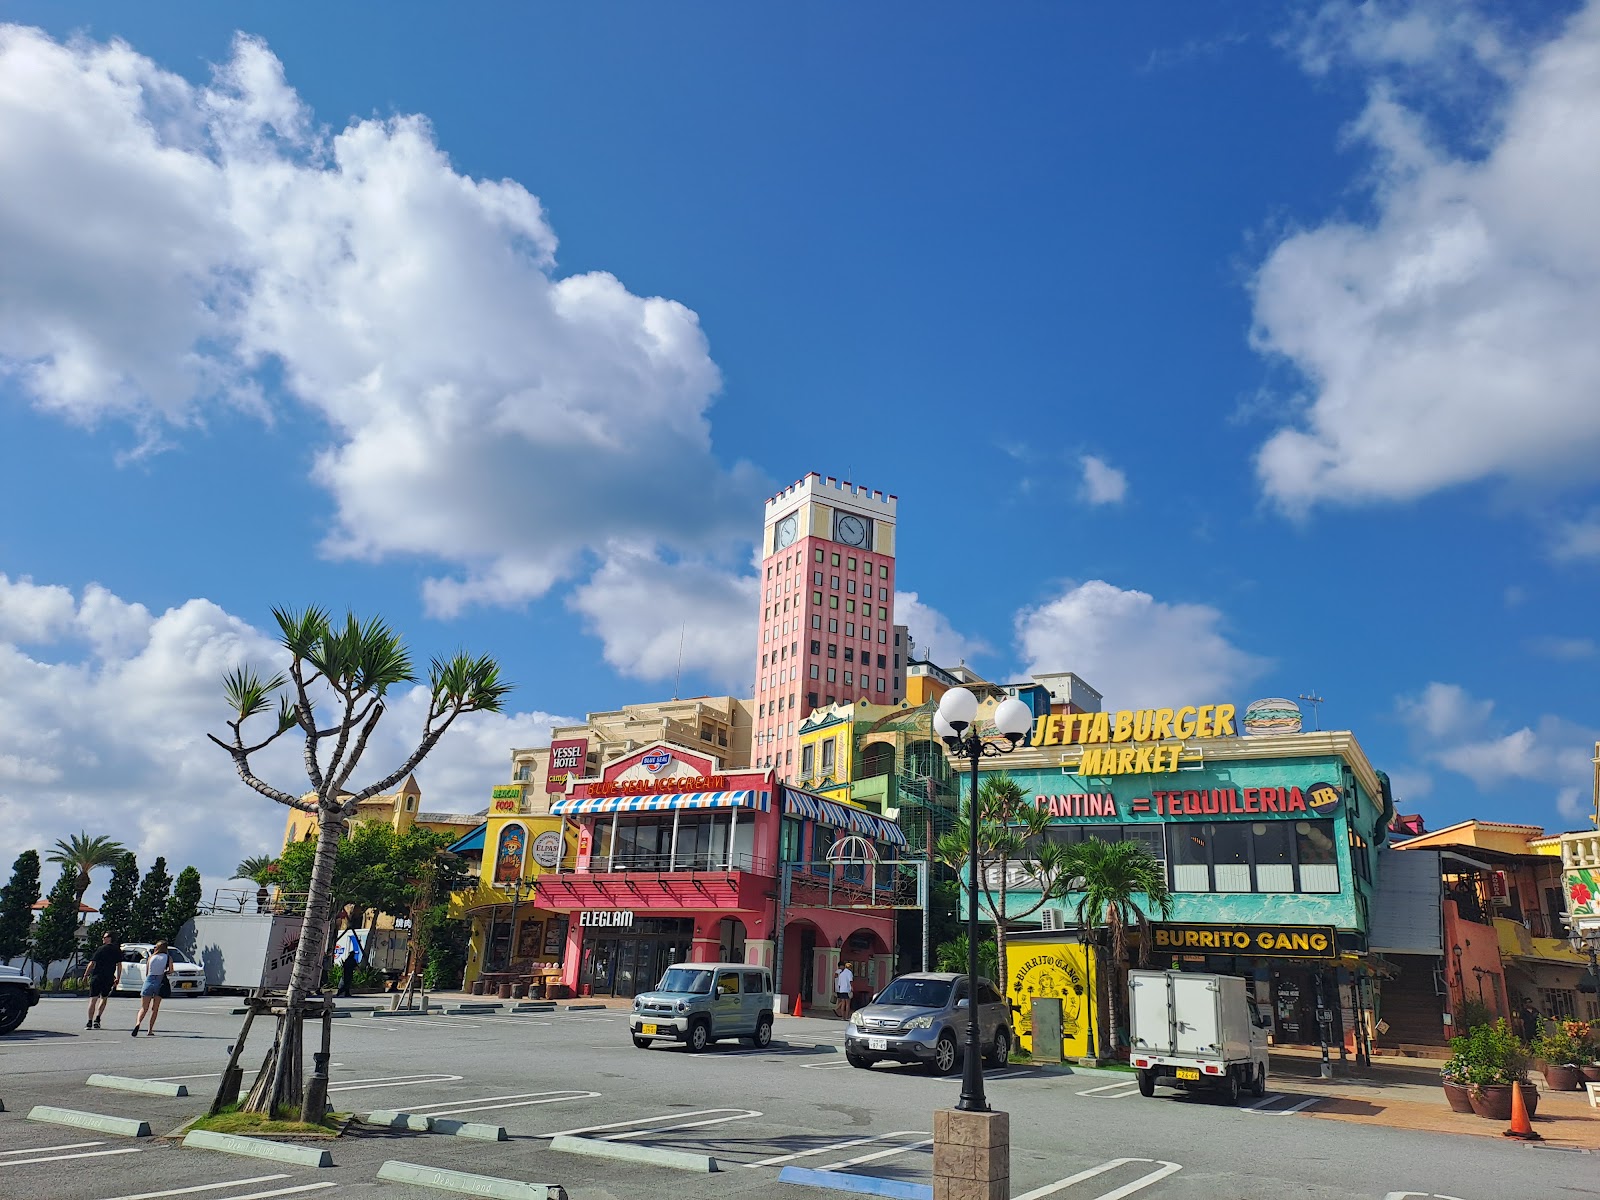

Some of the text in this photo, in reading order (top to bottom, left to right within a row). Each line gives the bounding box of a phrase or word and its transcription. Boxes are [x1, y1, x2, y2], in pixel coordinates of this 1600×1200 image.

[1030, 704, 1236, 747] JETTA BURGER
[553, 747, 582, 758] VESSEL
[1078, 746, 1184, 776] MARKET
[553, 758, 578, 768] HOTEL
[492, 789, 520, 799] MEXICAN
[587, 775, 725, 795] BLUE SEAL ICE CREAM
[495, 800, 515, 810] FOOD
[1152, 786, 1307, 815] TEQUILERIA
[1309, 787, 1338, 808] JB
[579, 911, 633, 928] ELEGLAM
[1155, 930, 1329, 951] BURRITO GANG
[1016, 955, 1080, 984] BURRITO GANG
